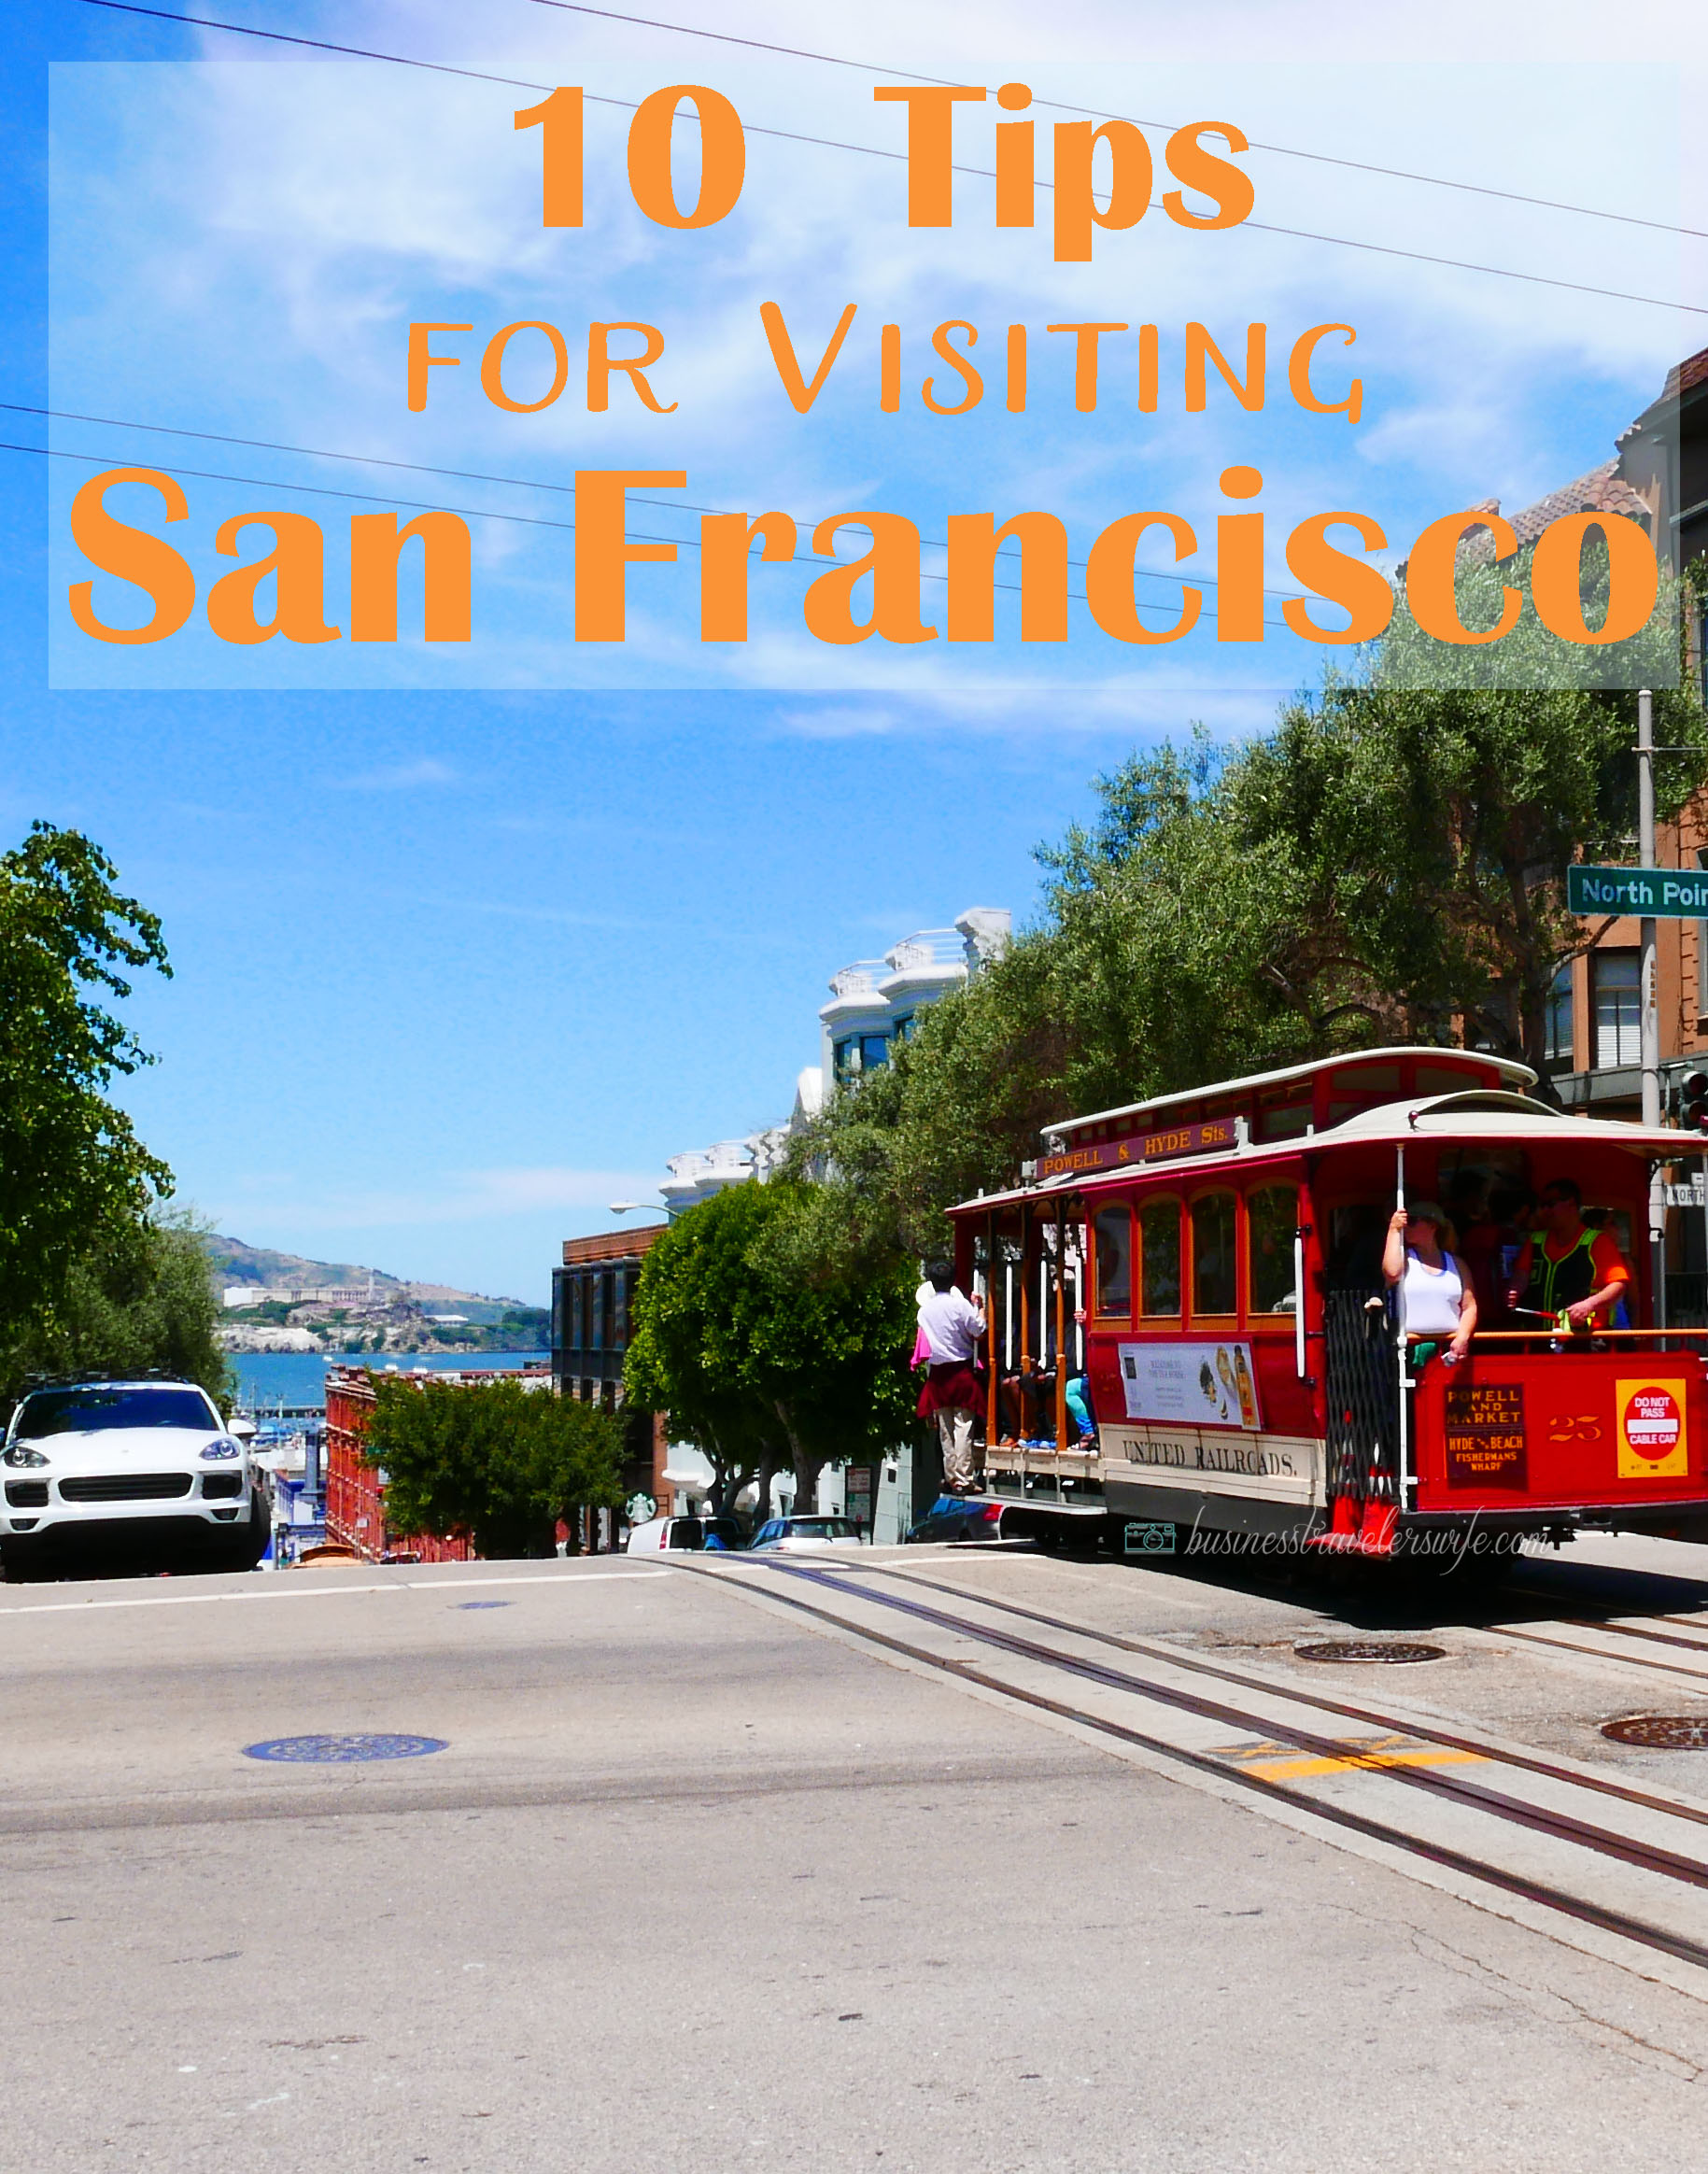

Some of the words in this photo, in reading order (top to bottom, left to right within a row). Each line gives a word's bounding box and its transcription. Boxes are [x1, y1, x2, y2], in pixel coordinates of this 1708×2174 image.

[1582, 878, 1653, 905] North
[1043, 1150, 1103, 1175] POWELL
[1118, 1143, 1129, 1161] &
[1145, 1131, 1192, 1155] HYDE
[1447, 1390, 1519, 1403] POWELL
[1634, 1397, 1650, 1407] DO
[1650, 1397, 1671, 1407] NOT
[1640, 1407, 1665, 1418] PASS
[1548, 1415, 1602, 1442] 25
[1448, 1437, 1475, 1450] HYDE
[1490, 1435, 1523, 1449] BEACH
[1630, 1434, 1657, 1445] CABLE
[1659, 1433, 1676, 1444] CAR
[1122, 1440, 1186, 1466] UNITED
[1456, 1451, 1517, 1462] FISHERMANS
[1471, 1461, 1503, 1472] WHARF
